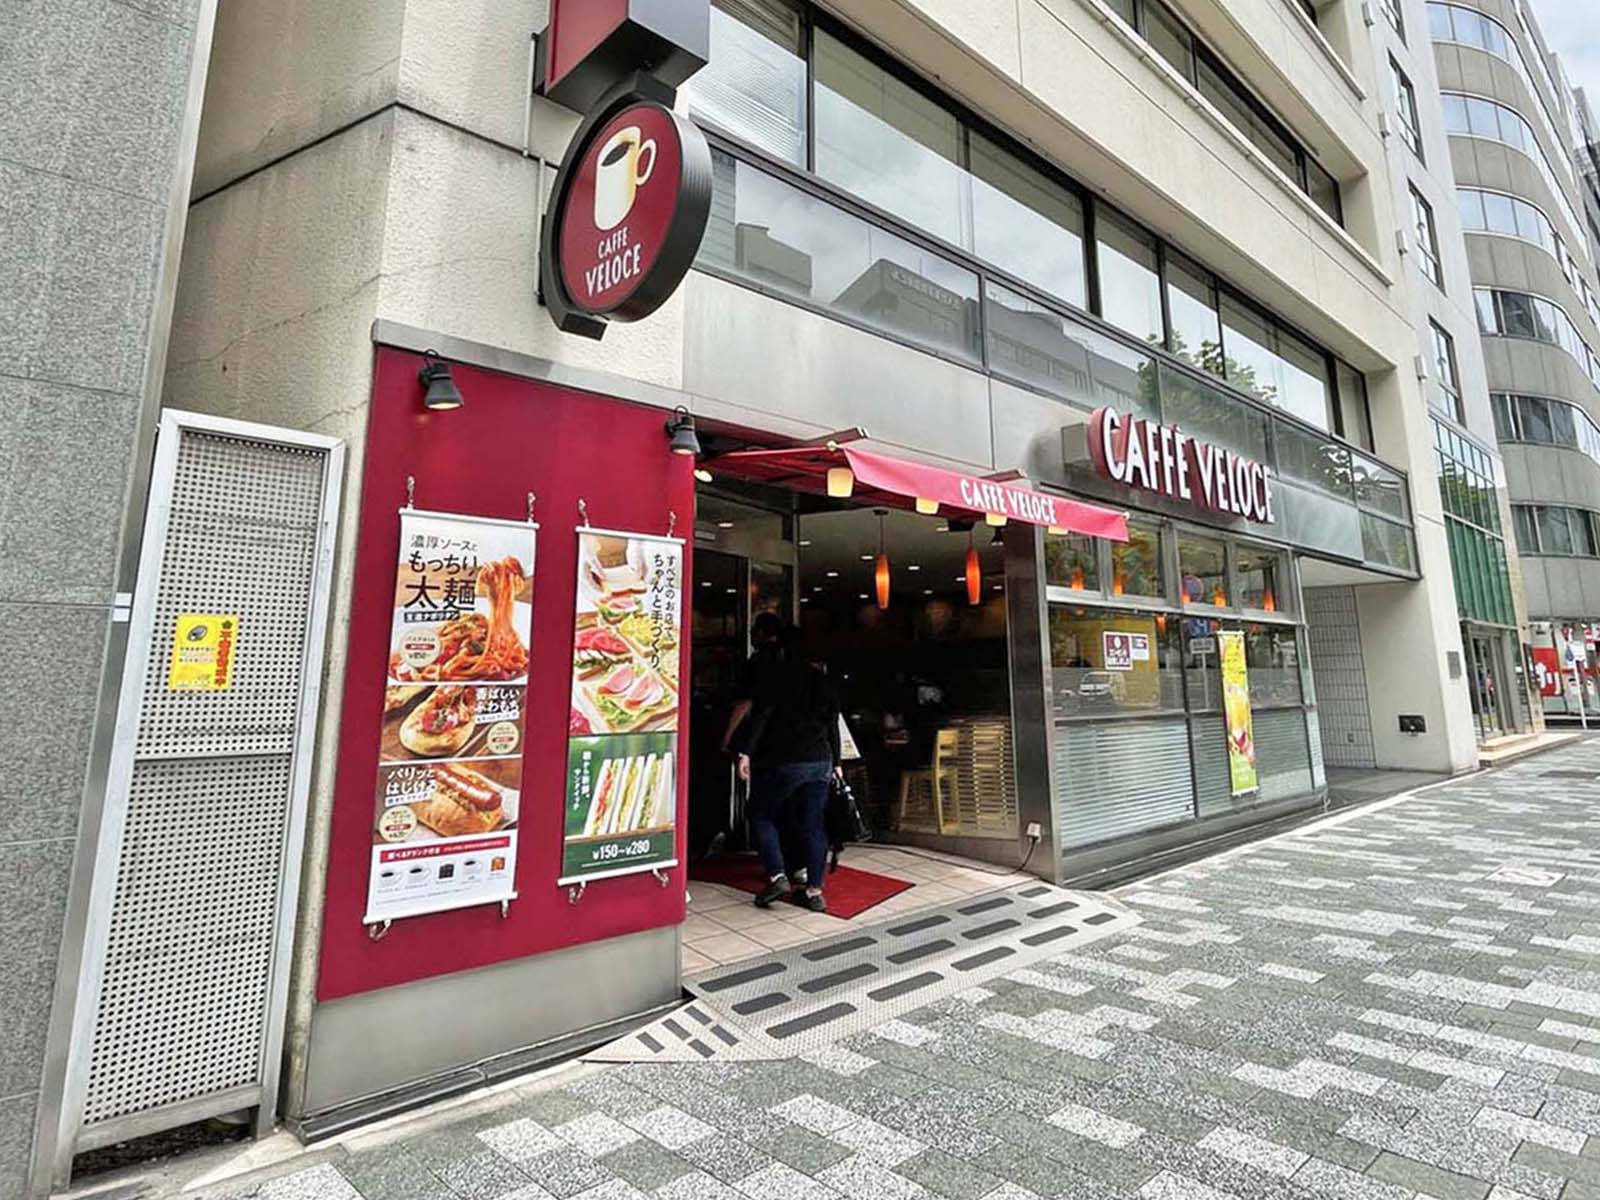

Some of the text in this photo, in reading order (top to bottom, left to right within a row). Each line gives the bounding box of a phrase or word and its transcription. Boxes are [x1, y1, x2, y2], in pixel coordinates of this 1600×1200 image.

[585, 243, 641, 297] VELOCE
[1193, 440, 1276, 523] VELOCE
[1006, 489, 1058, 524] VELOCE
[408, 550, 478, 577] もっちり
[385, 780, 437, 797] はじける
